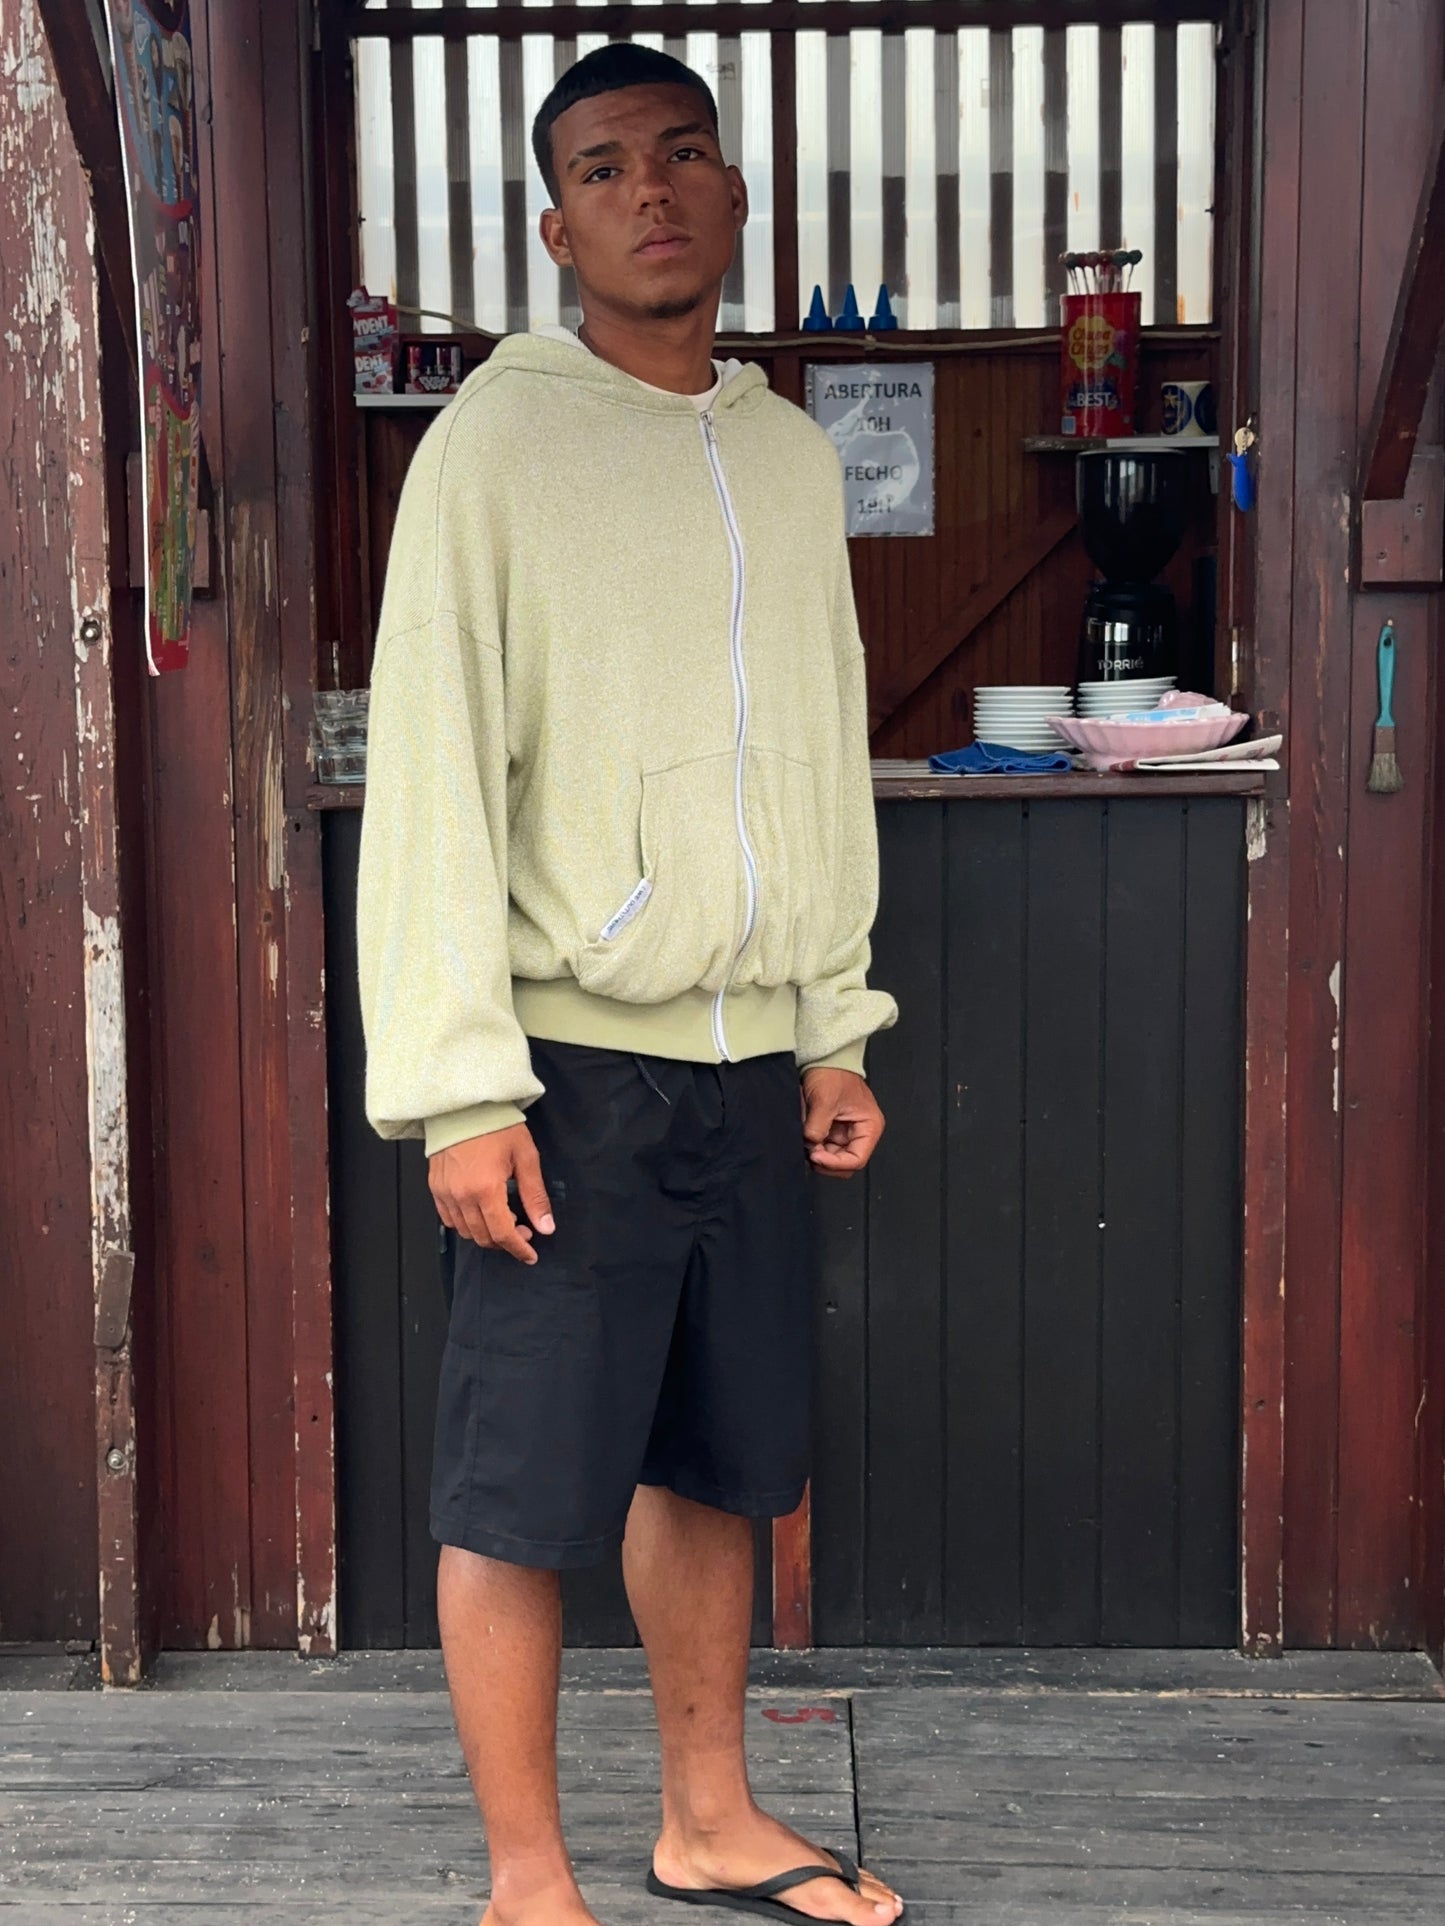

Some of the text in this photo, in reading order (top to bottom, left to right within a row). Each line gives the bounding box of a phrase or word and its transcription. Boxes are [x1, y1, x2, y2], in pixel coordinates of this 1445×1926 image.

[824, 382, 922, 400] ABERTURA
[1076, 391, 1112, 407] BEST
[845, 465, 903, 481] FECHO
